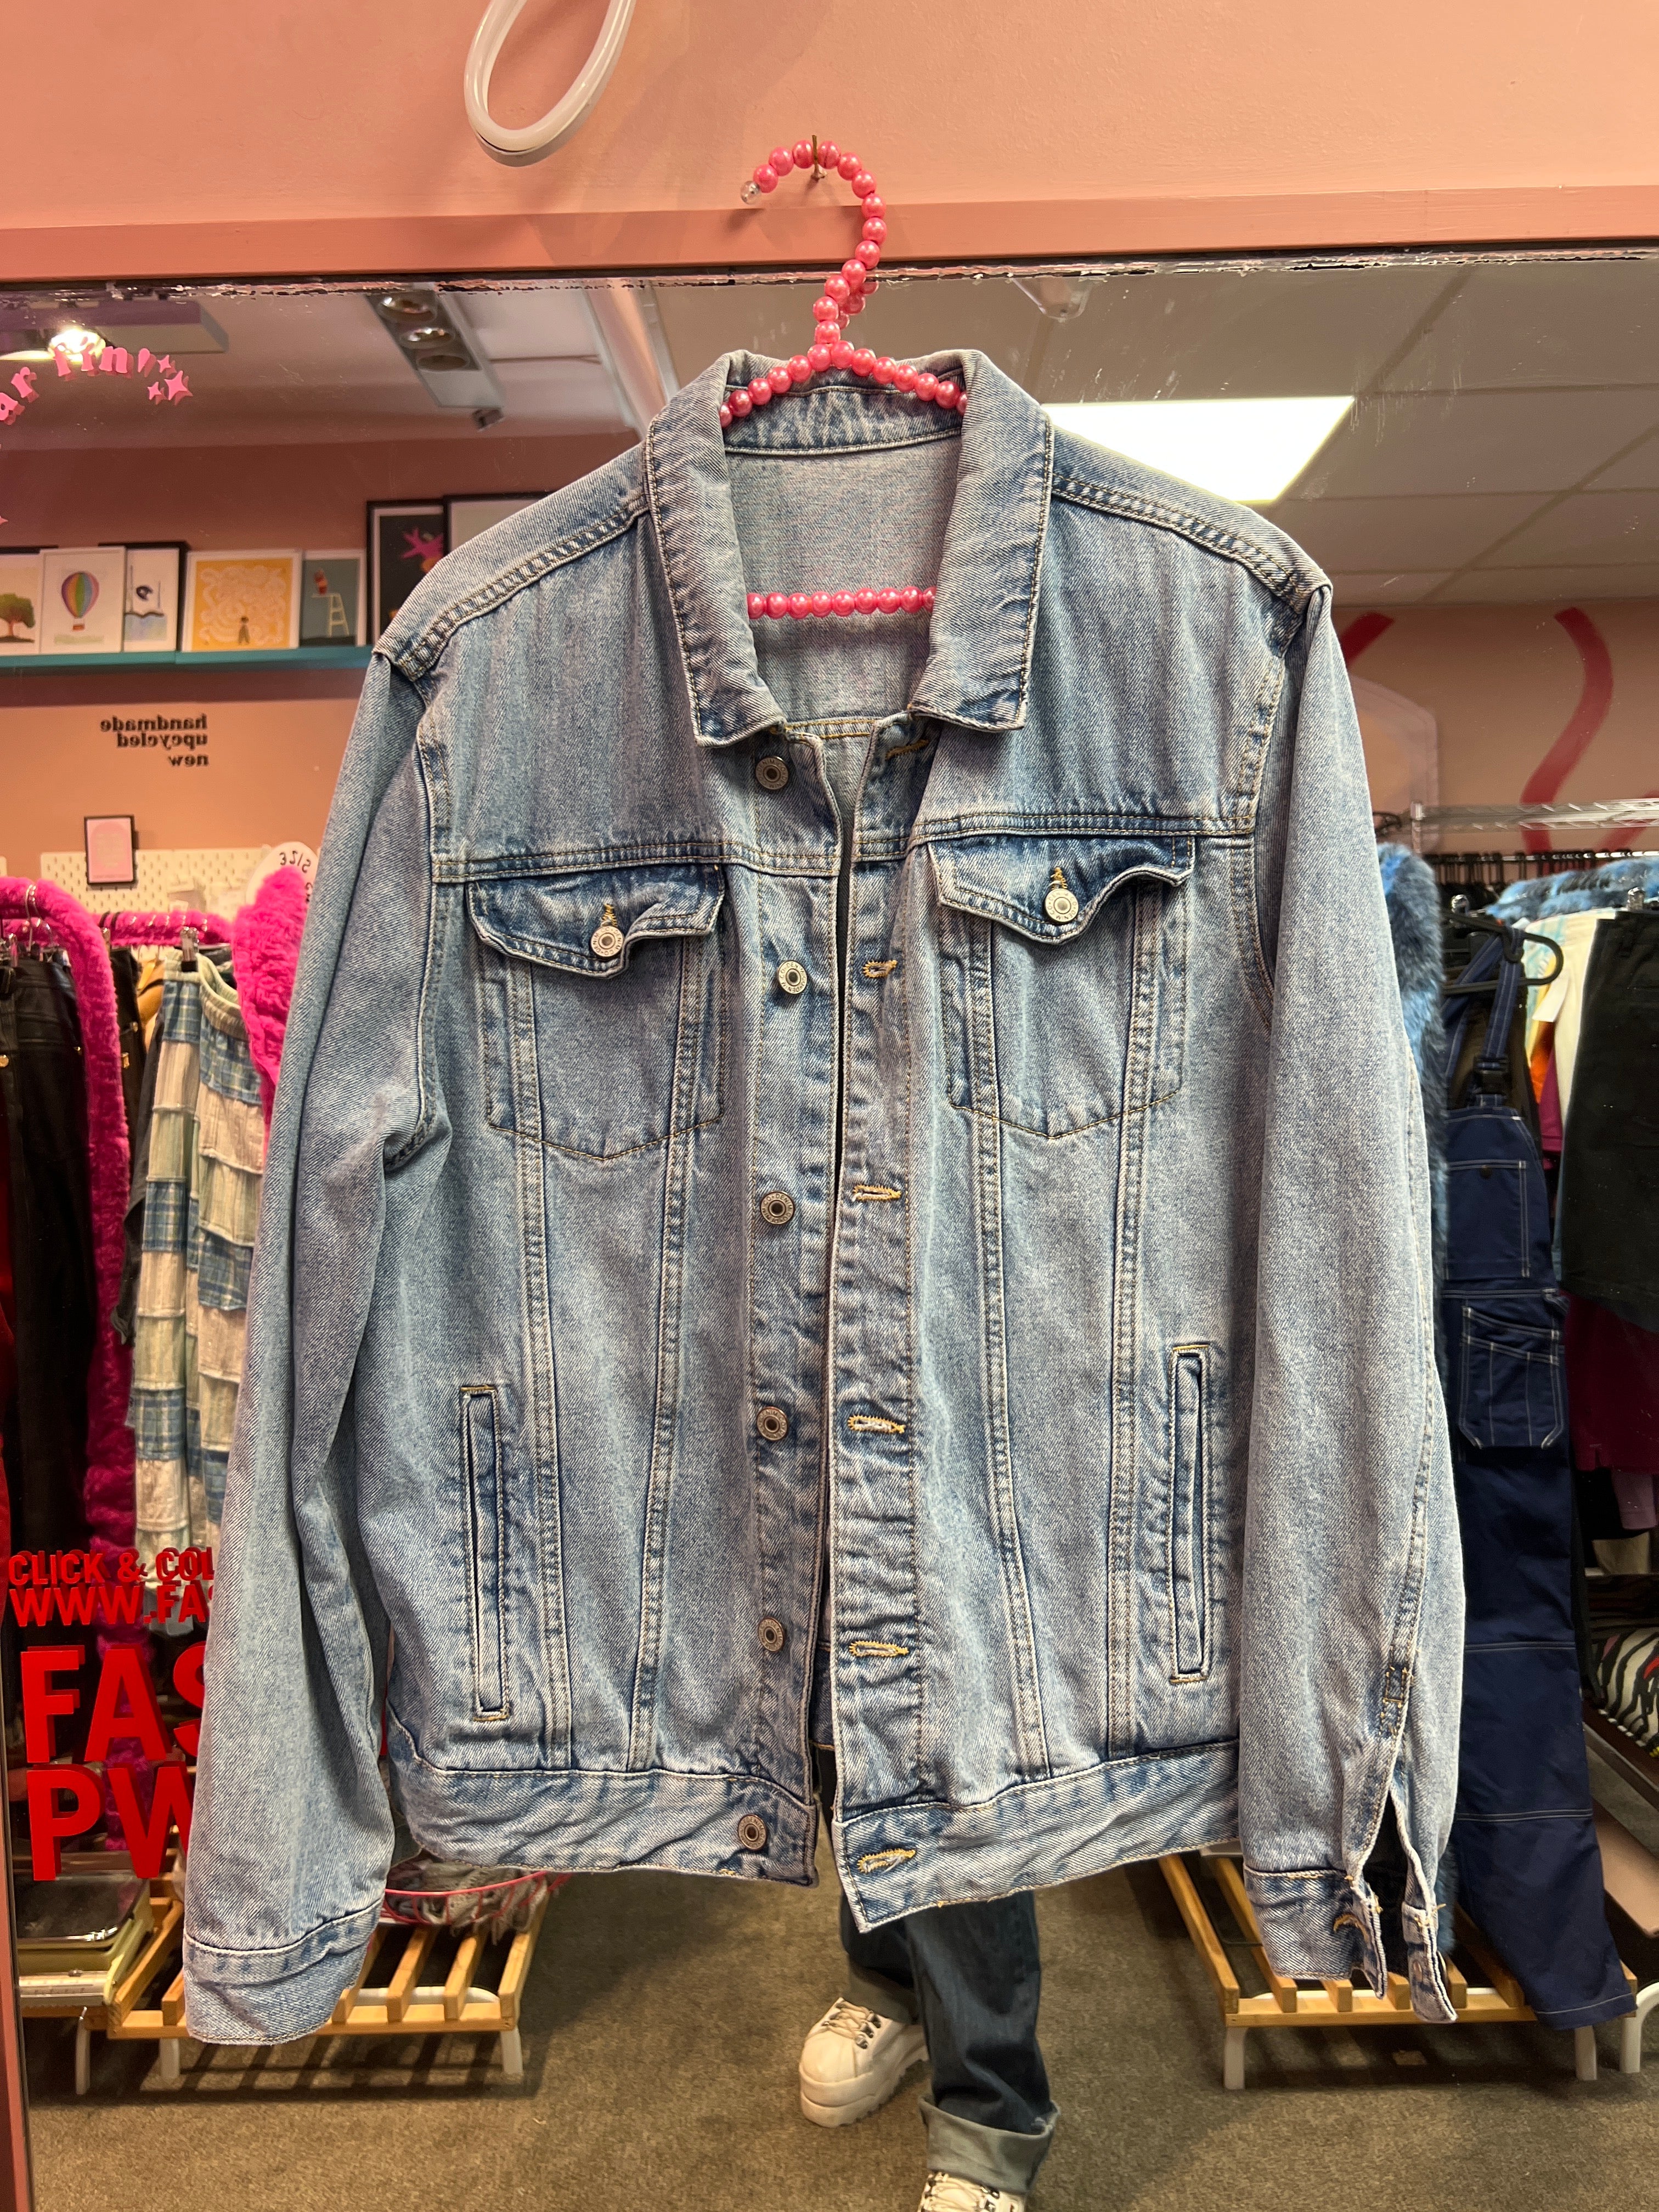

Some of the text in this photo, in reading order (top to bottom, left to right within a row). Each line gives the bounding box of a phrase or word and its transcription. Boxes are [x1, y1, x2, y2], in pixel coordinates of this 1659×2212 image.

[8, 1553, 105, 1585] CLICK
[117, 1553, 141, 1583] &
[9, 1584, 213, 1627] WWW.FA
